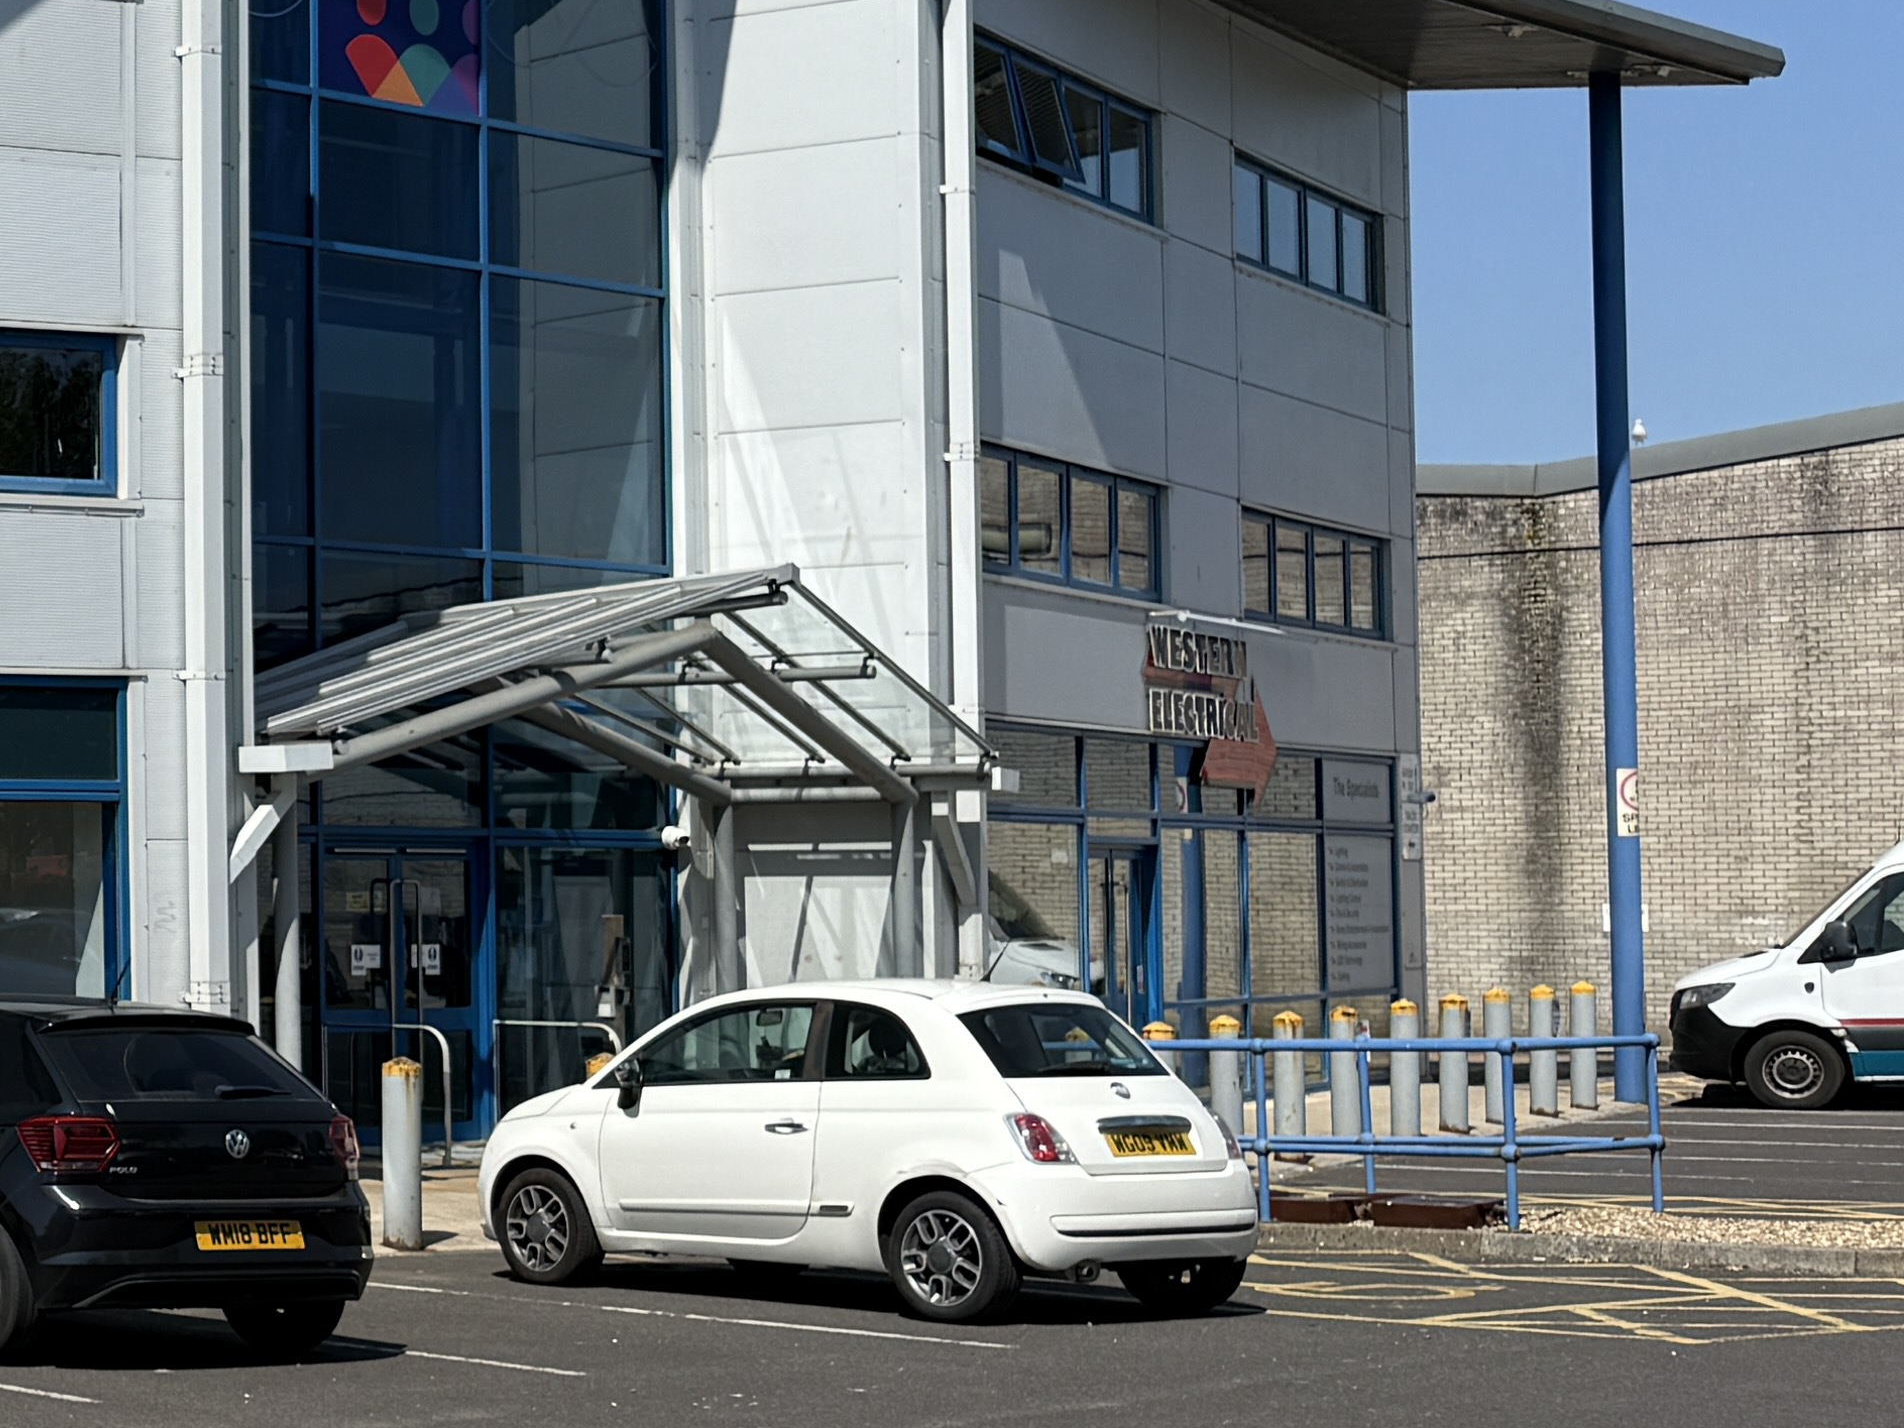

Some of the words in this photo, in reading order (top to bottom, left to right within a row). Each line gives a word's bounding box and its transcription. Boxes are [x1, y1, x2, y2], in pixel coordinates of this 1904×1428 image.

[1148, 624, 1248, 679] WESTERN
[1149, 688, 1259, 742] ELECTRICAL
[208, 1222, 252, 1245] WM18
[255, 1222, 290, 1244] BFF
